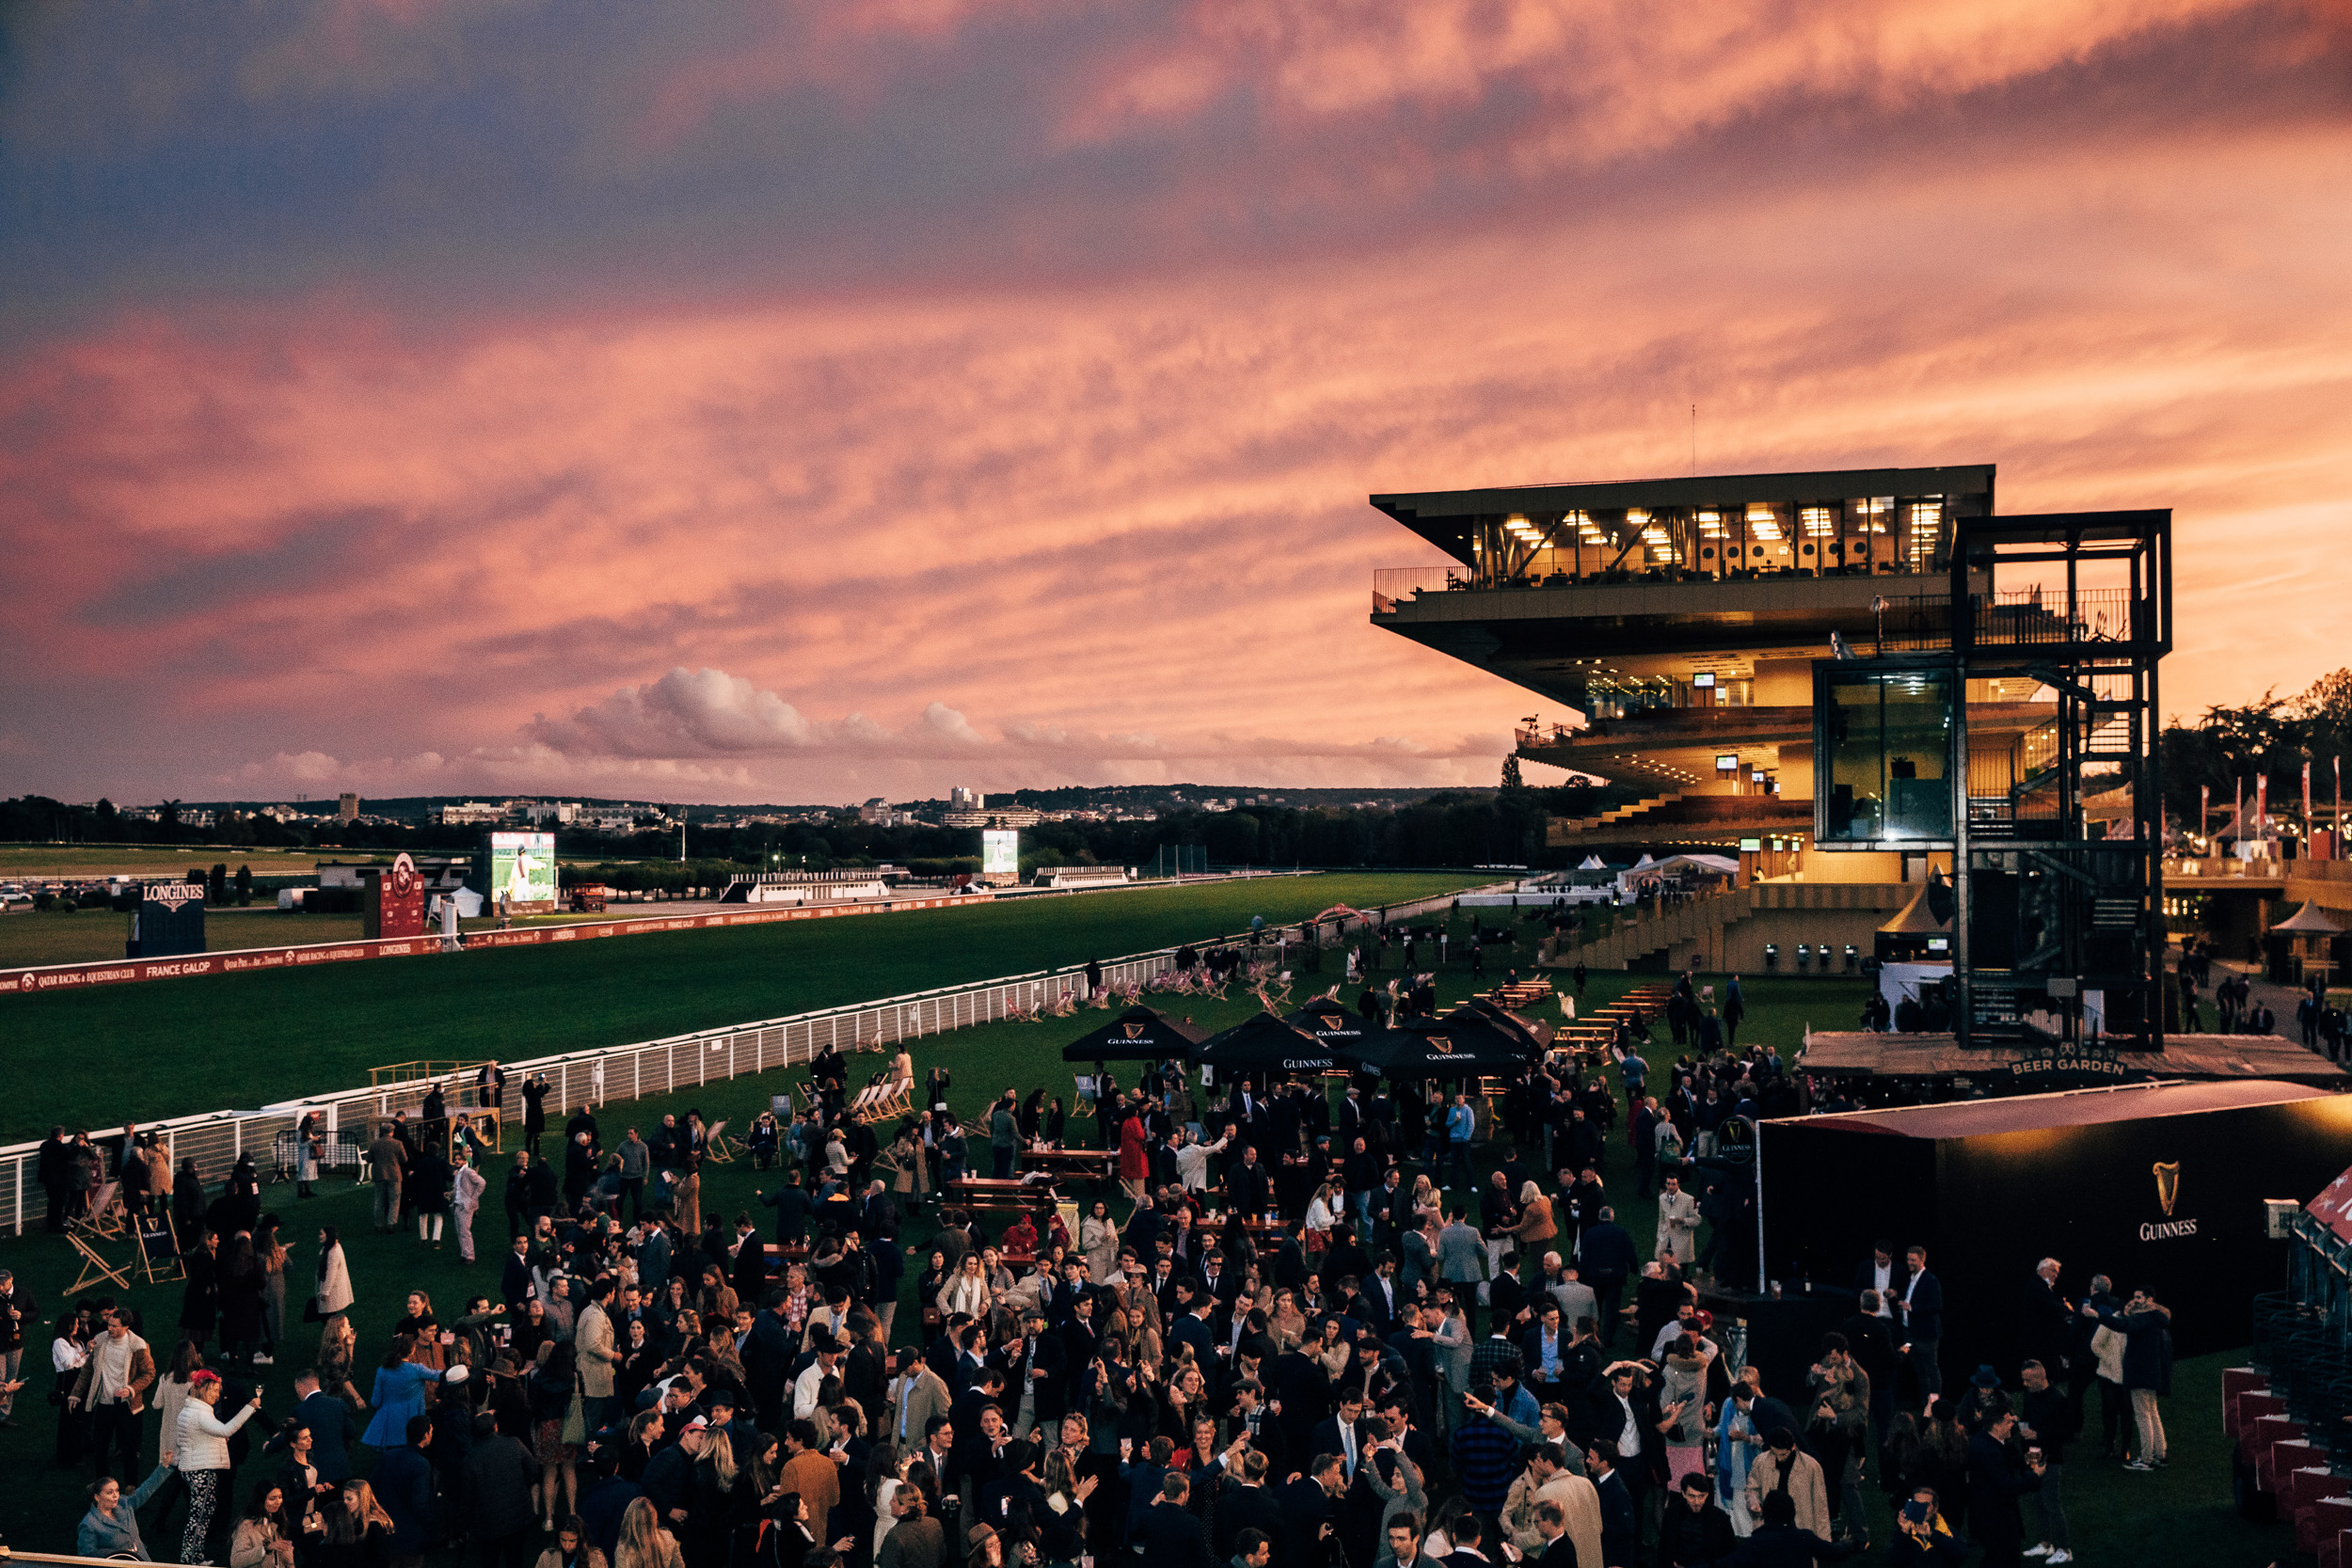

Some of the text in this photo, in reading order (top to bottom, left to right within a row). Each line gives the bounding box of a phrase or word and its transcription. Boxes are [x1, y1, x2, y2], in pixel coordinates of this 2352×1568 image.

[143, 884, 204, 901] LONGINES
[379, 943, 411, 956] LONGINES
[146, 961, 211, 977] FRANCE GALOP
[39, 975, 58, 989] QATAR
[58, 974, 81, 985] RACING
[87, 970, 120, 983] EQUESTRIAN
[120, 968, 135, 979] CLUB
[1283, 1058, 1333, 1069] GUINNESS
[2011, 1058, 2125, 1076] BEER GARDEN
[2139, 1218, 2198, 1242] GUINNESS
